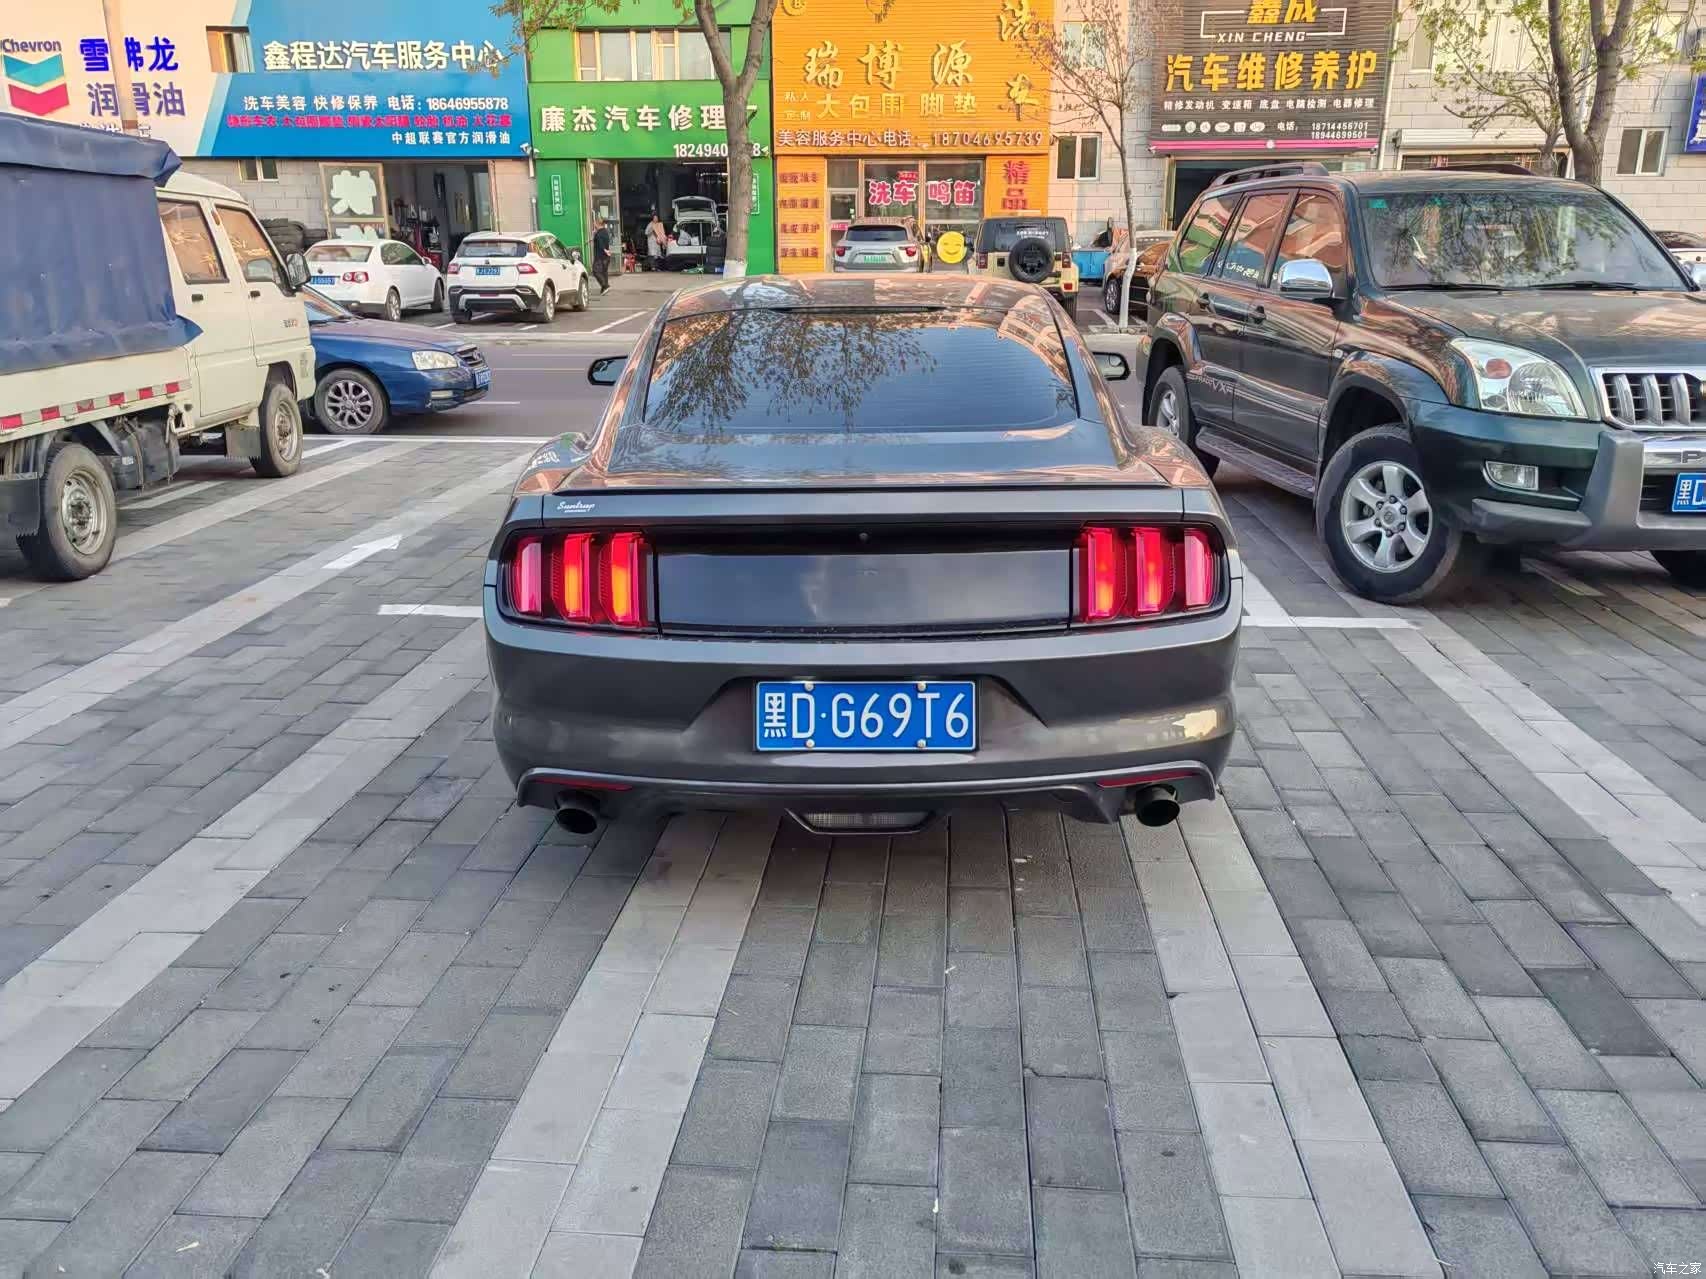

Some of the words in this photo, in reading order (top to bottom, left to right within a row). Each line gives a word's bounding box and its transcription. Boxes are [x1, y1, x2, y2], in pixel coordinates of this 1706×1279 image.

[2, 38, 61, 53] Chevron
[1217, 32, 1244, 43] XIN
[1252, 31, 1306, 42] CHENG
[264, 40, 503, 70] 鑫程达汽车服务中心
[805, 40, 973, 90] 瑞博源
[1166, 51, 1377, 92] 汽车维修养护
[244, 95, 306, 111] 洗车美容
[313, 95, 378, 111] 快修保养
[541, 104, 757, 131] 廉杰汽车修理
[391, 131, 510, 145] 中超联赛官方润滑油
[934, 131, 1043, 146] 18704695739
[673, 143, 761, 157] 18249408
[869, 180, 916, 205] 洗车
[928, 180, 976, 206] 鸣笛
[764, 692, 969, 739] 黑D·G69T6
